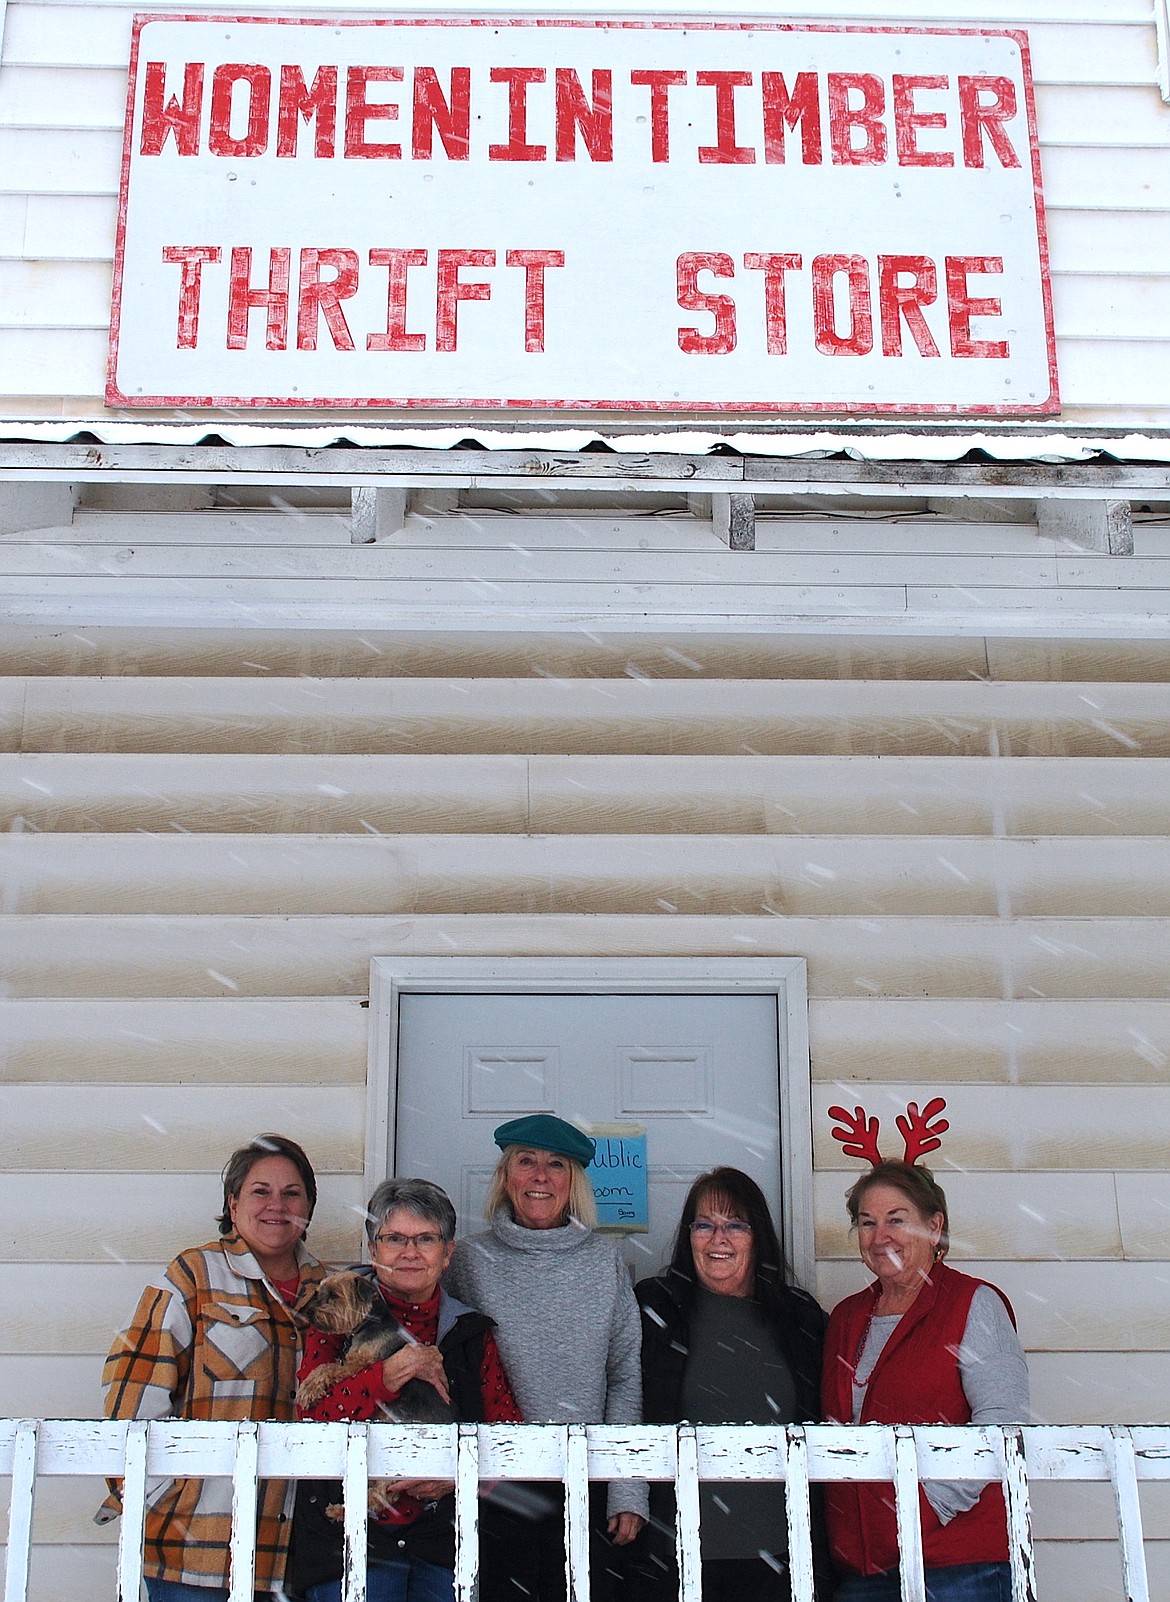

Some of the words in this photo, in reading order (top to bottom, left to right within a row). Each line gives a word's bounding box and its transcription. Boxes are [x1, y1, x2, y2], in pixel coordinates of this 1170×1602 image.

[140, 62, 471, 160] WOMEN
[489, 66, 613, 162] IN
[630, 70, 1022, 168] TIMBER
[162, 246, 565, 353] THRIFT
[676, 252, 1010, 358] STORE
[592, 1186, 633, 1198] oom
